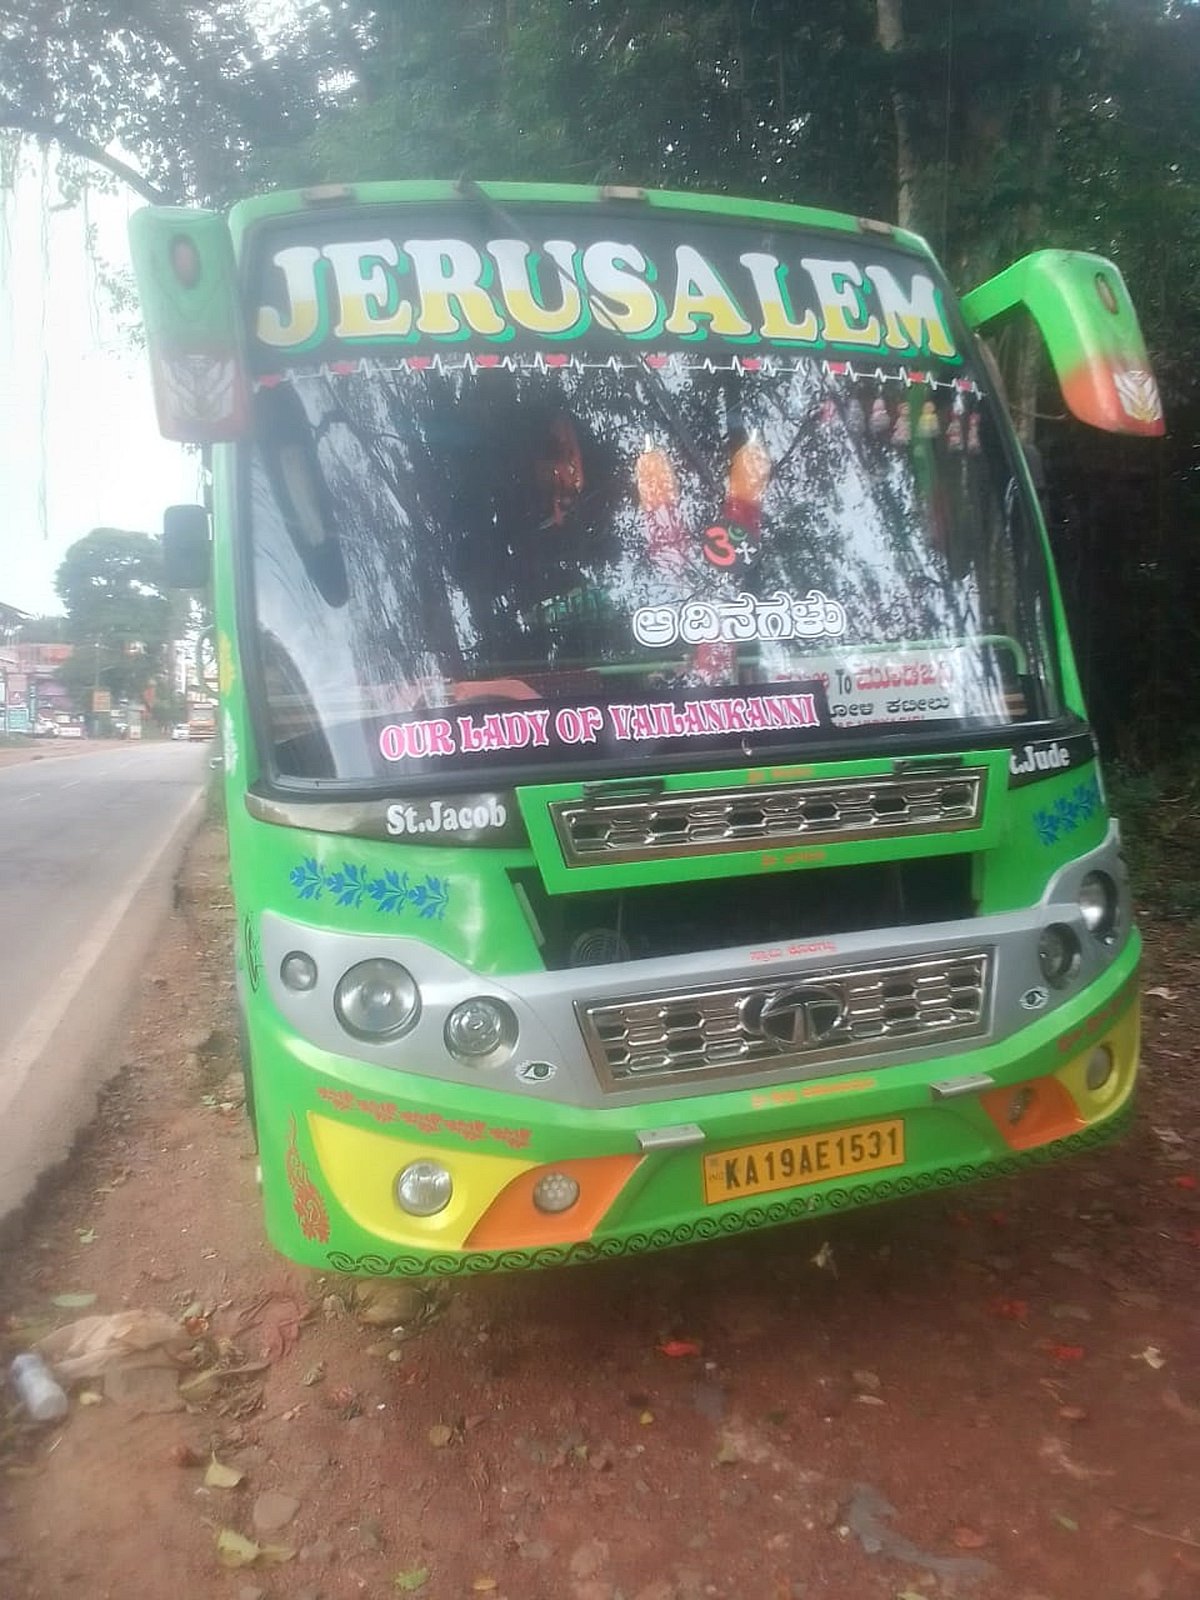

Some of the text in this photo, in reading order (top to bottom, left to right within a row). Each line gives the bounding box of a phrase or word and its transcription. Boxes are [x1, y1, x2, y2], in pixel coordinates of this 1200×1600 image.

[256, 238, 960, 362] JERUSALEM
[835, 669, 852, 695] To
[379, 694, 820, 761] OUR LADY OF VAILANKANNI
[386, 798, 506, 836] St.Jacob
[725, 1127, 898, 1190] KA19AE1531
